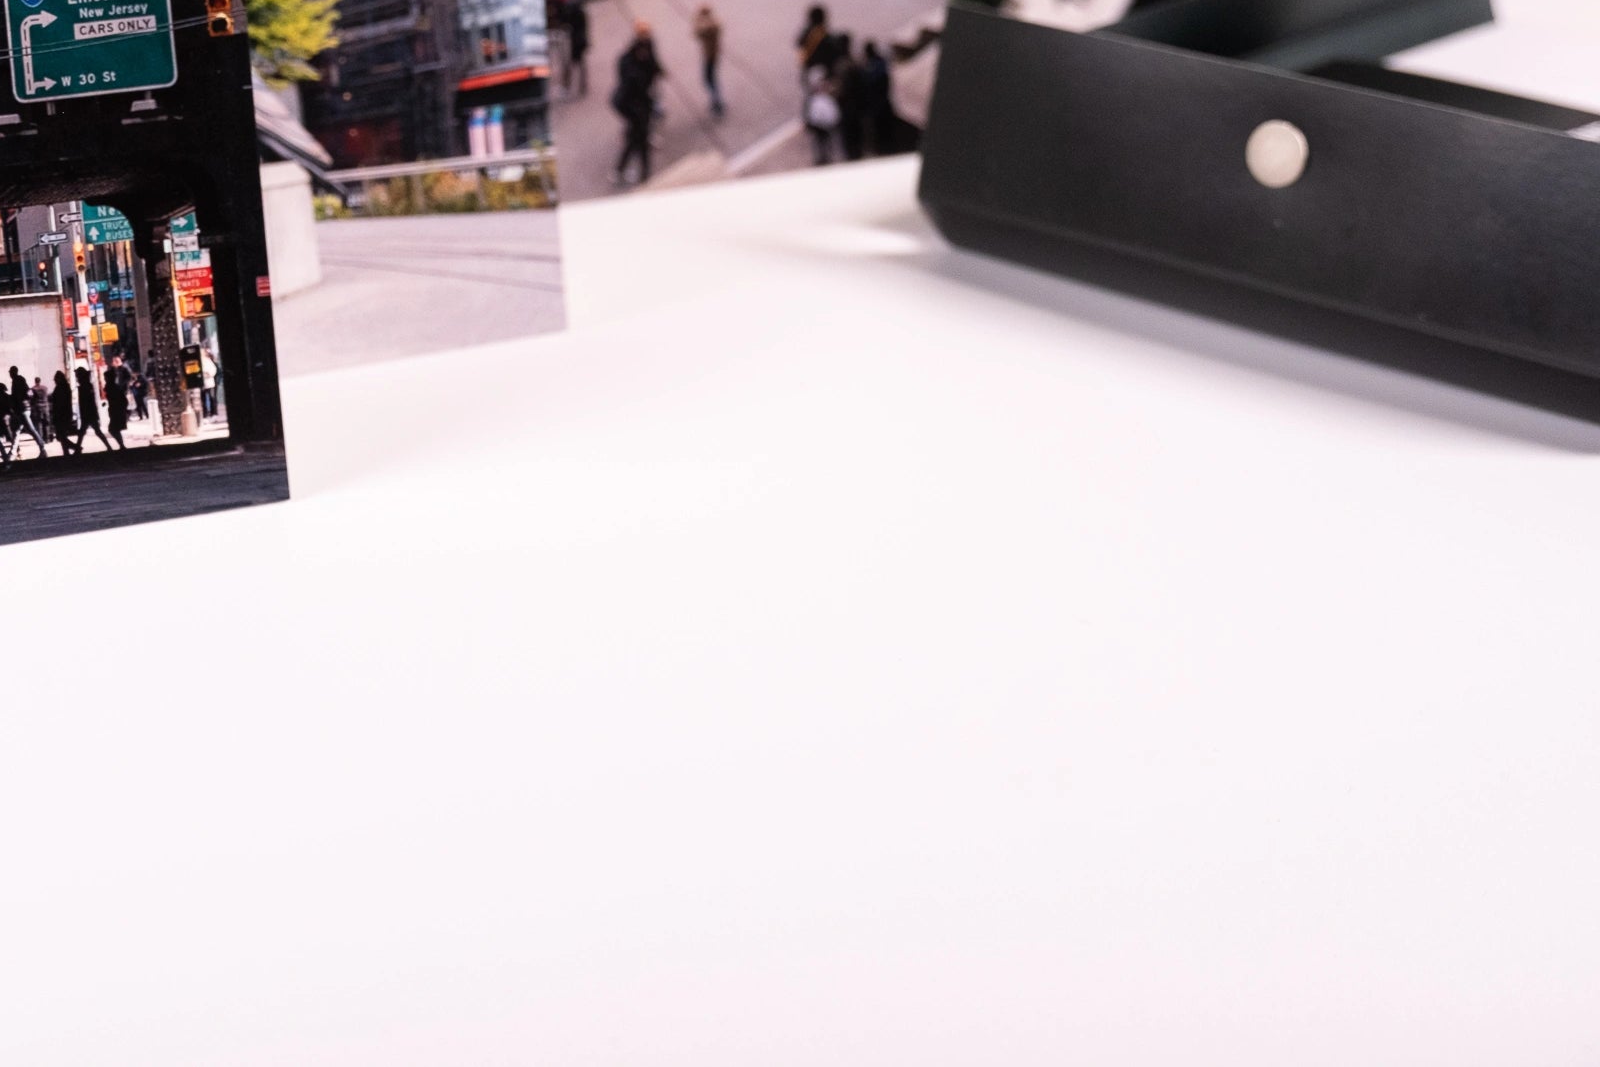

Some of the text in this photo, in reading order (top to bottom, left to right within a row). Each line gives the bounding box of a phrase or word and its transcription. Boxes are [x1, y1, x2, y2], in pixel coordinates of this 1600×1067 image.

[79, 3, 148, 19] New Jersey
[79, 18, 152, 36] CARS ONLY
[61, 71, 117, 87] W 30 St
[97, 205, 121, 217] Ne
